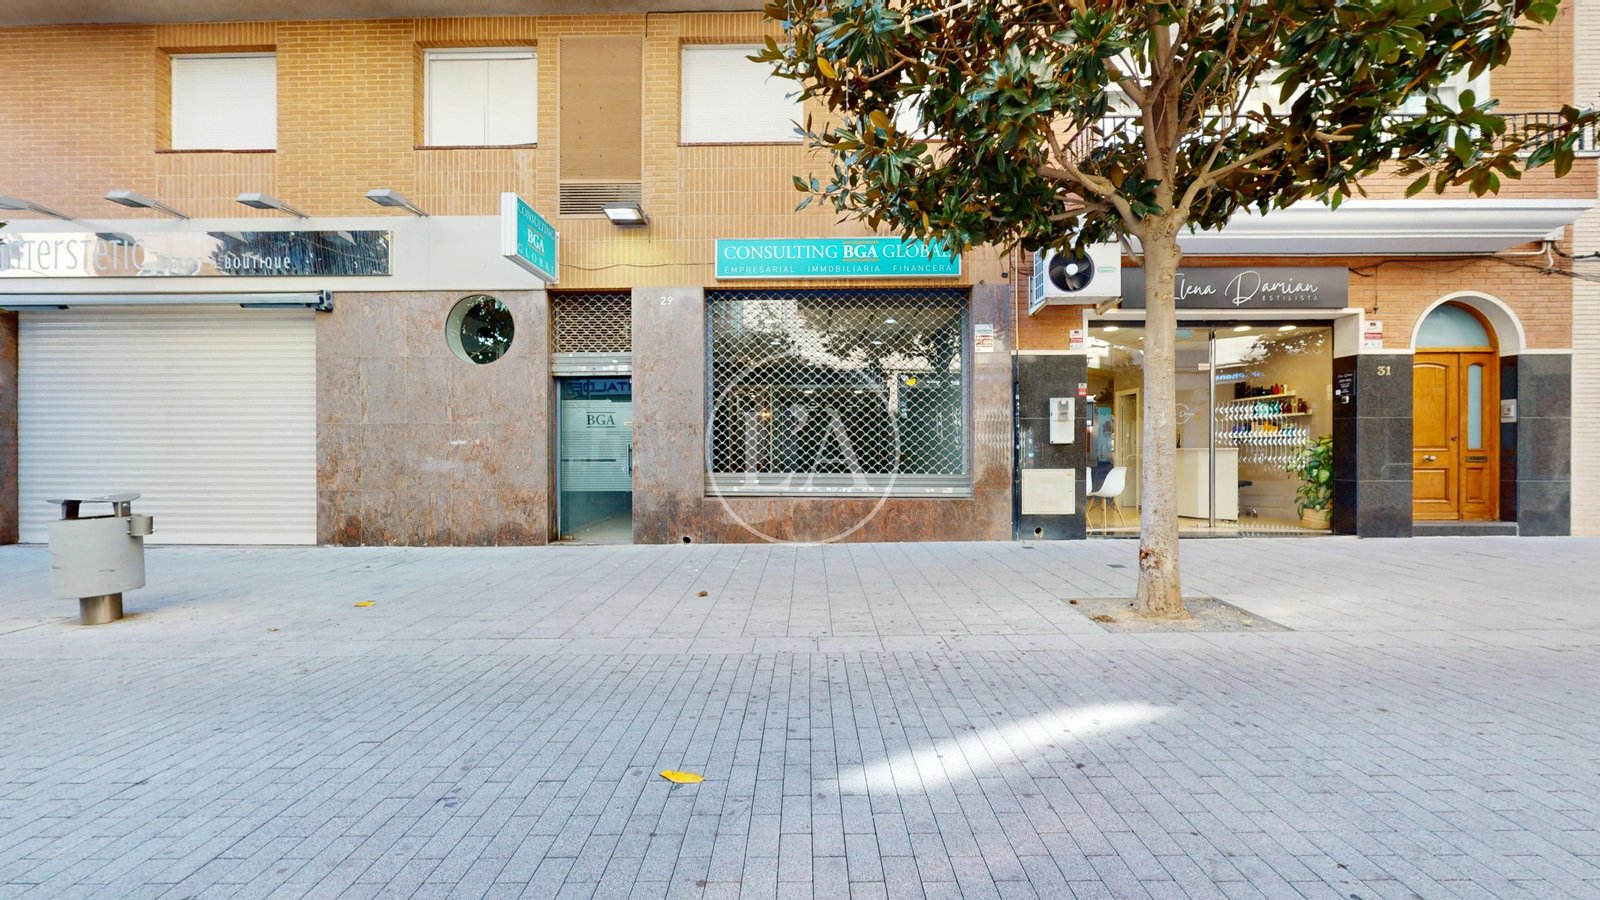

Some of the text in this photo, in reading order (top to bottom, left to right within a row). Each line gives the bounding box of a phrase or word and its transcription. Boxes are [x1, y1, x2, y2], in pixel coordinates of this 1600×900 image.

[527, 228, 545, 253] BGA
[724, 245, 838, 260] CONSULTING
[843, 246, 878, 258] BGA
[807, 265, 880, 273] IMMOBILIARIA
[893, 264, 952, 272] FINANCERA
[1224, 270, 1318, 306] Damian
[660, 296, 673, 306] 29
[1377, 366, 1391, 376] 31
[586, 414, 615, 426] BGA
